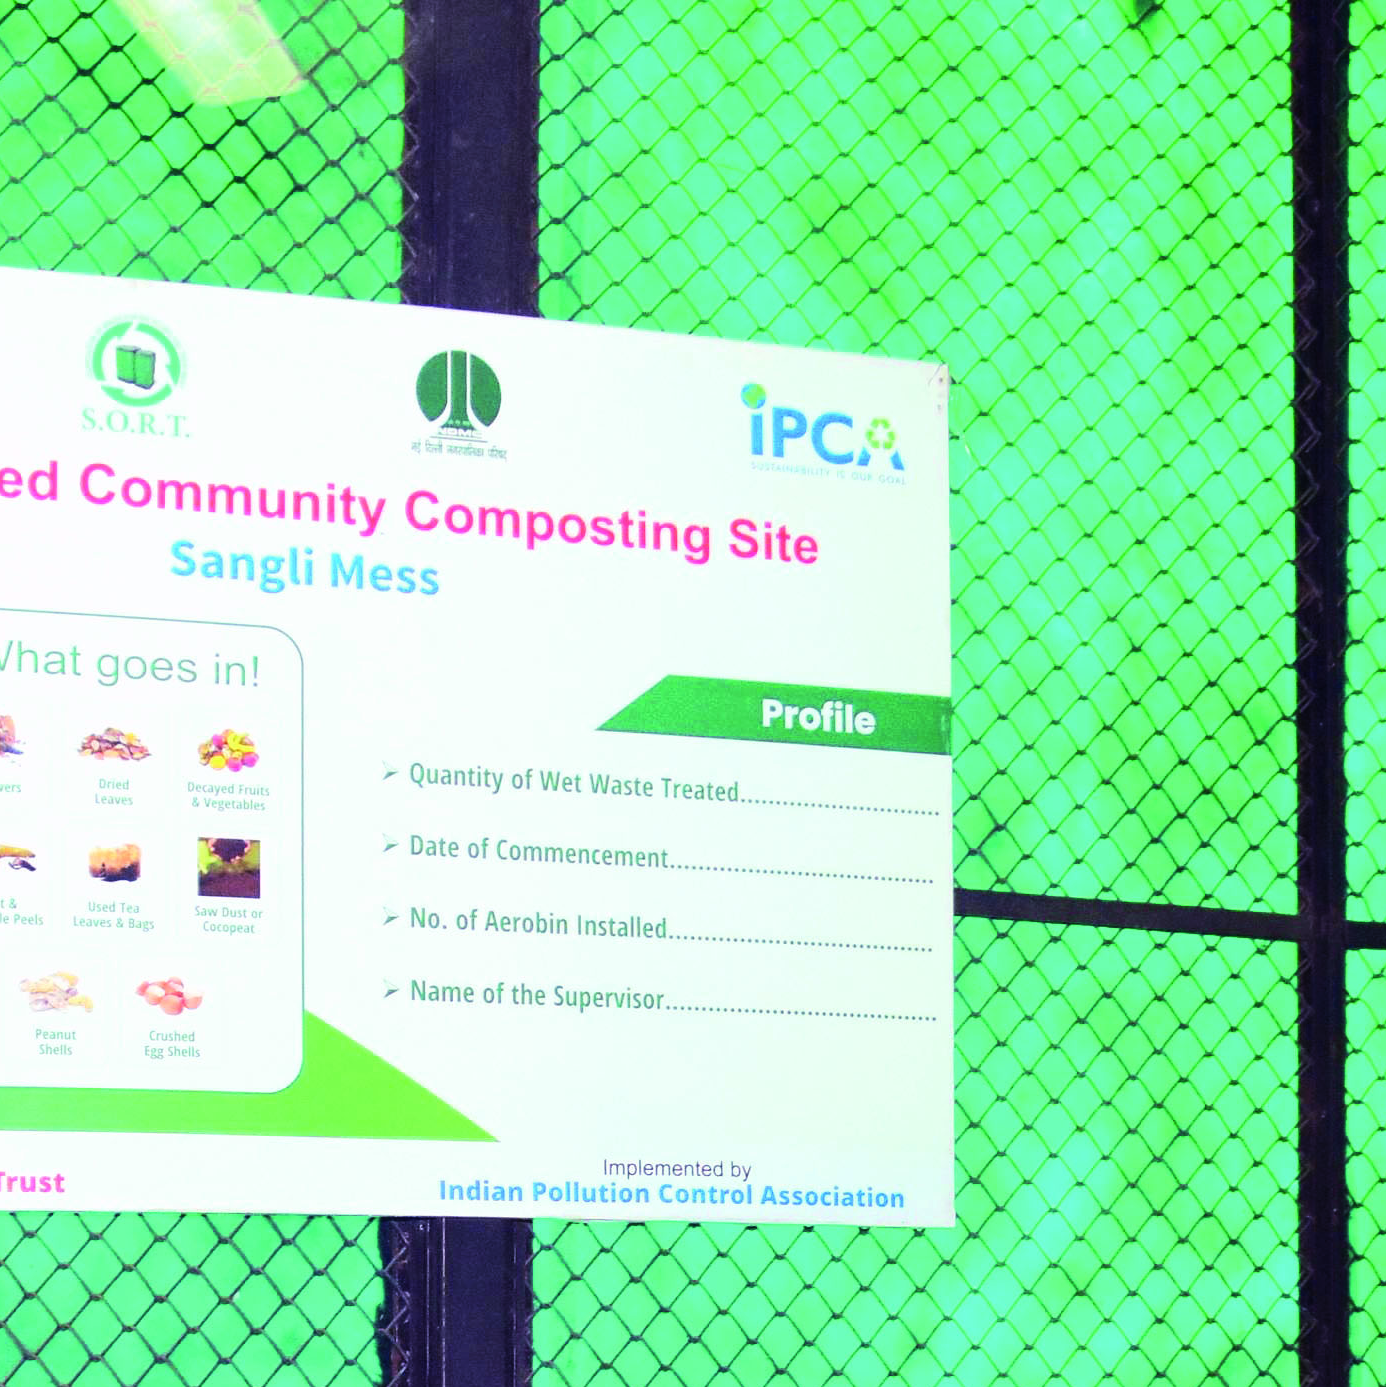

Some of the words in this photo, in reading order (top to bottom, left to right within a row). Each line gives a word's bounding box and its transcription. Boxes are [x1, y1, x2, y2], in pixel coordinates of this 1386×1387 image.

[81, 407, 191, 438] S.O.R.T.
[79, 462, 386, 537] Community
[404, 489, 711, 565] Composting
[728, 516, 819, 564] Site
[170, 540, 314, 593] Sangli
[329, 551, 440, 596] Mess
[97, 653, 198, 687] goes
[213, 652, 259, 687] in!
[762, 698, 878, 737] Profile
[98, 778, 130, 791] Dried
[409, 761, 504, 795] Quantity
[511, 768, 534, 791] of
[539, 770, 583, 793] Wet
[589, 774, 655, 799] Waste
[187, 781, 235, 797] Decayed
[238, 784, 270, 797] Fruits
[94, 793, 134, 807] Leaves
[191, 796, 201, 808] &
[203, 797, 266, 813] Vegetables
[410, 834, 460, 860] Date
[467, 838, 489, 860] of
[9, 898, 17, 909] &
[88, 901, 117, 914] Used
[119, 902, 140, 914] Tea
[13, 912, 44, 926] Peels
[194, 906, 218, 918] Saw
[221, 906, 247, 919] Dust
[249, 908, 263, 919] or
[73, 916, 113, 929] Leaves
[116, 917, 126, 929] &
[128, 917, 155, 932] Bags
[203, 921, 256, 937] Cocopeat
[410, 906, 448, 931] No.
[455, 908, 479, 932] of
[485, 911, 569, 937] Aerobin
[411, 980, 474, 1004] Name
[482, 982, 505, 1005] of
[511, 983, 547, 1007] the
[35, 1028, 76, 1041] Peanut
[149, 1030, 195, 1043] Crushed
[39, 1044, 73, 1056] Shells
[144, 1045, 165, 1059] Egg
[168, 1045, 201, 1058] Shells
[603, 1158, 724, 1181] Implemented
[730, 1160, 752, 1182] by
[439, 1180, 523, 1202] Indian
[532, 1181, 650, 1204] Pollution
[658, 1183, 753, 1206] Control
[760, 1185, 906, 1209] Association
